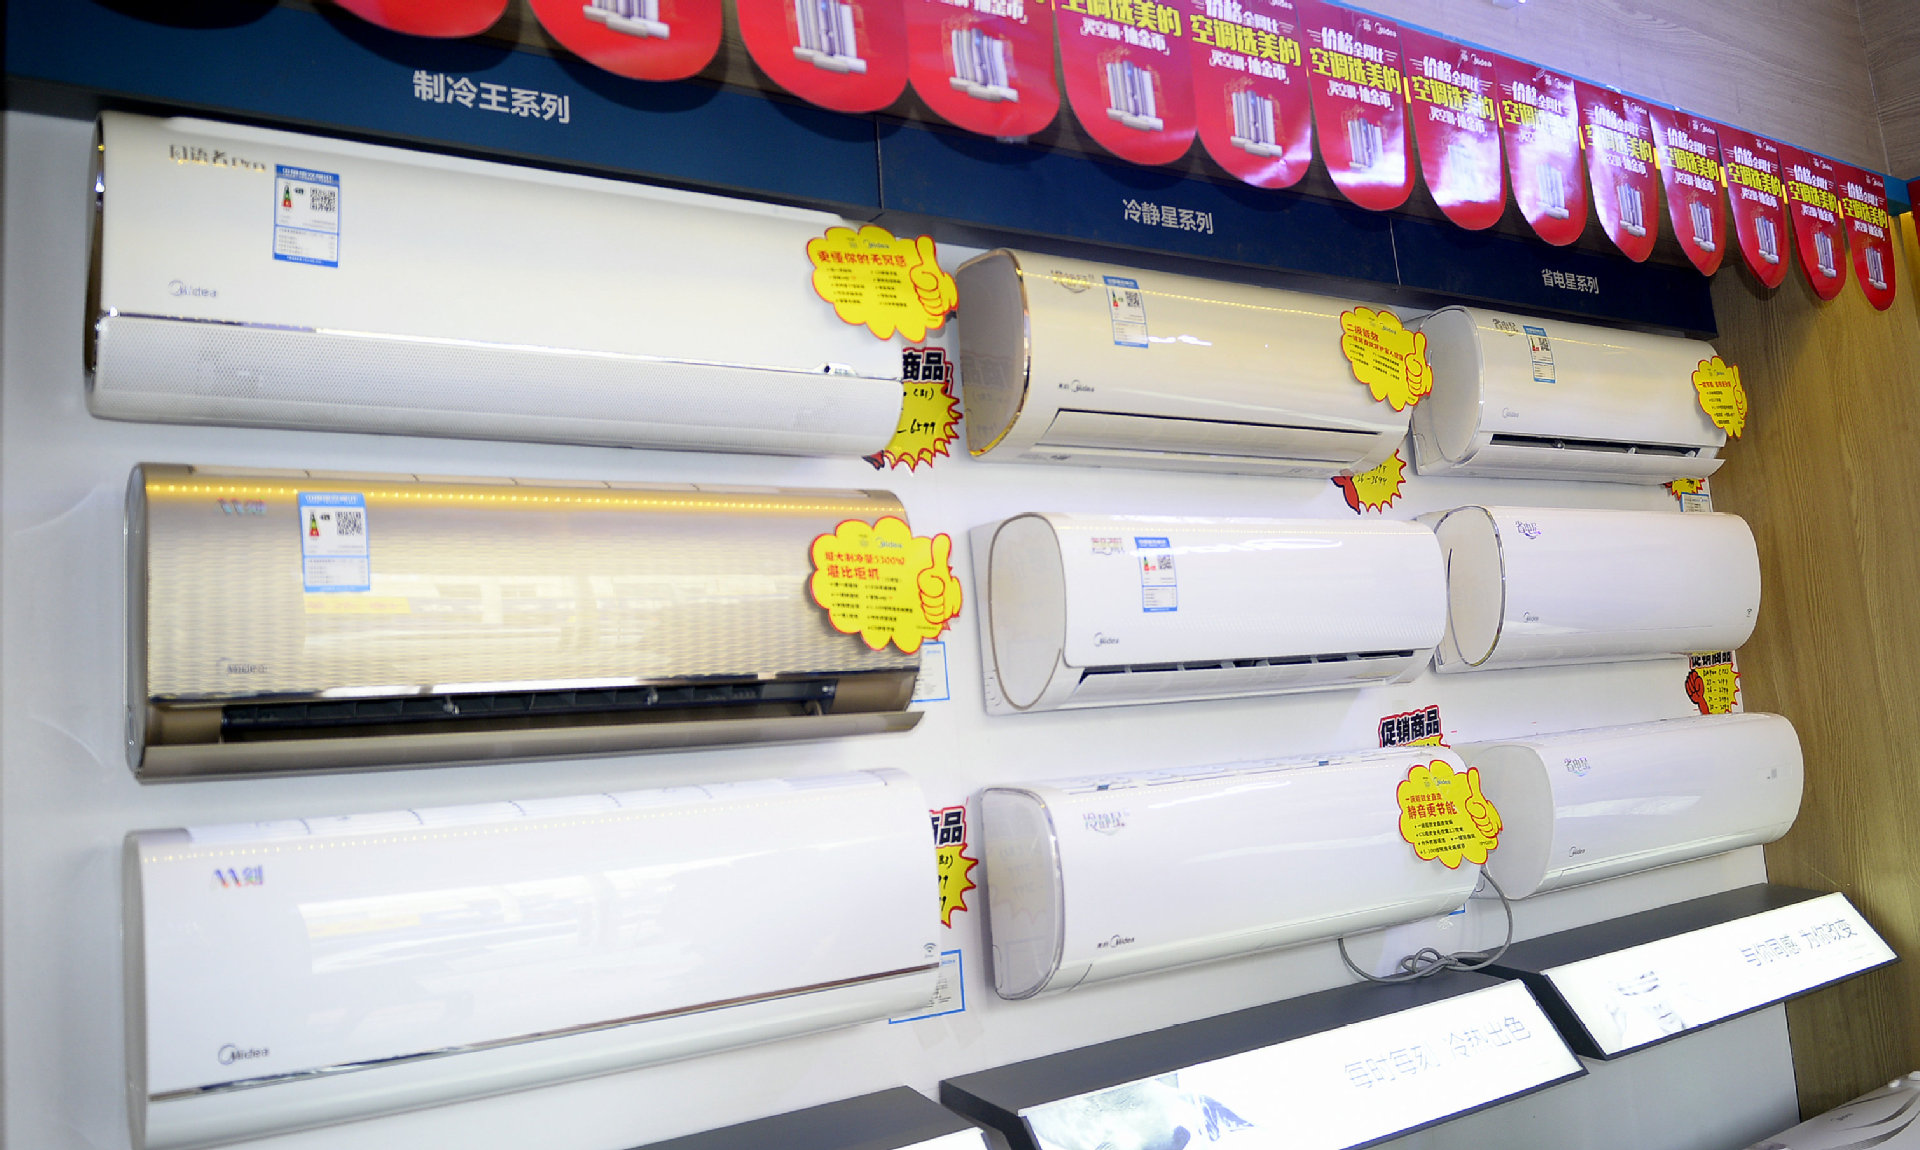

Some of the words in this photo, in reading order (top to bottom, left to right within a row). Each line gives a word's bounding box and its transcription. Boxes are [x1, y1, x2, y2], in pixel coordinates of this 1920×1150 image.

[1190, 14, 1302, 67] 空调选美的
[1310, 47, 1402, 95] 空调选美的
[413, 70, 570, 124] 制冷王系列
[1411, 75, 1496, 121] 空调选美的
[1727, 162, 1783, 198] 空调选美的
[1123, 199, 1214, 234] 冷静星系列
[168, 279, 217, 298] Midea
[1541, 268, 1600, 295] 省电星系列
[903, 352, 944, 380] 商品
[1381, 709, 1439, 747] 促销商品
[1407, 801, 1457, 819] 静音更节能
[931, 811, 963, 845] 品
[217, 1043, 271, 1066] Midea
[1344, 1045, 1441, 1089] 每时每刻
